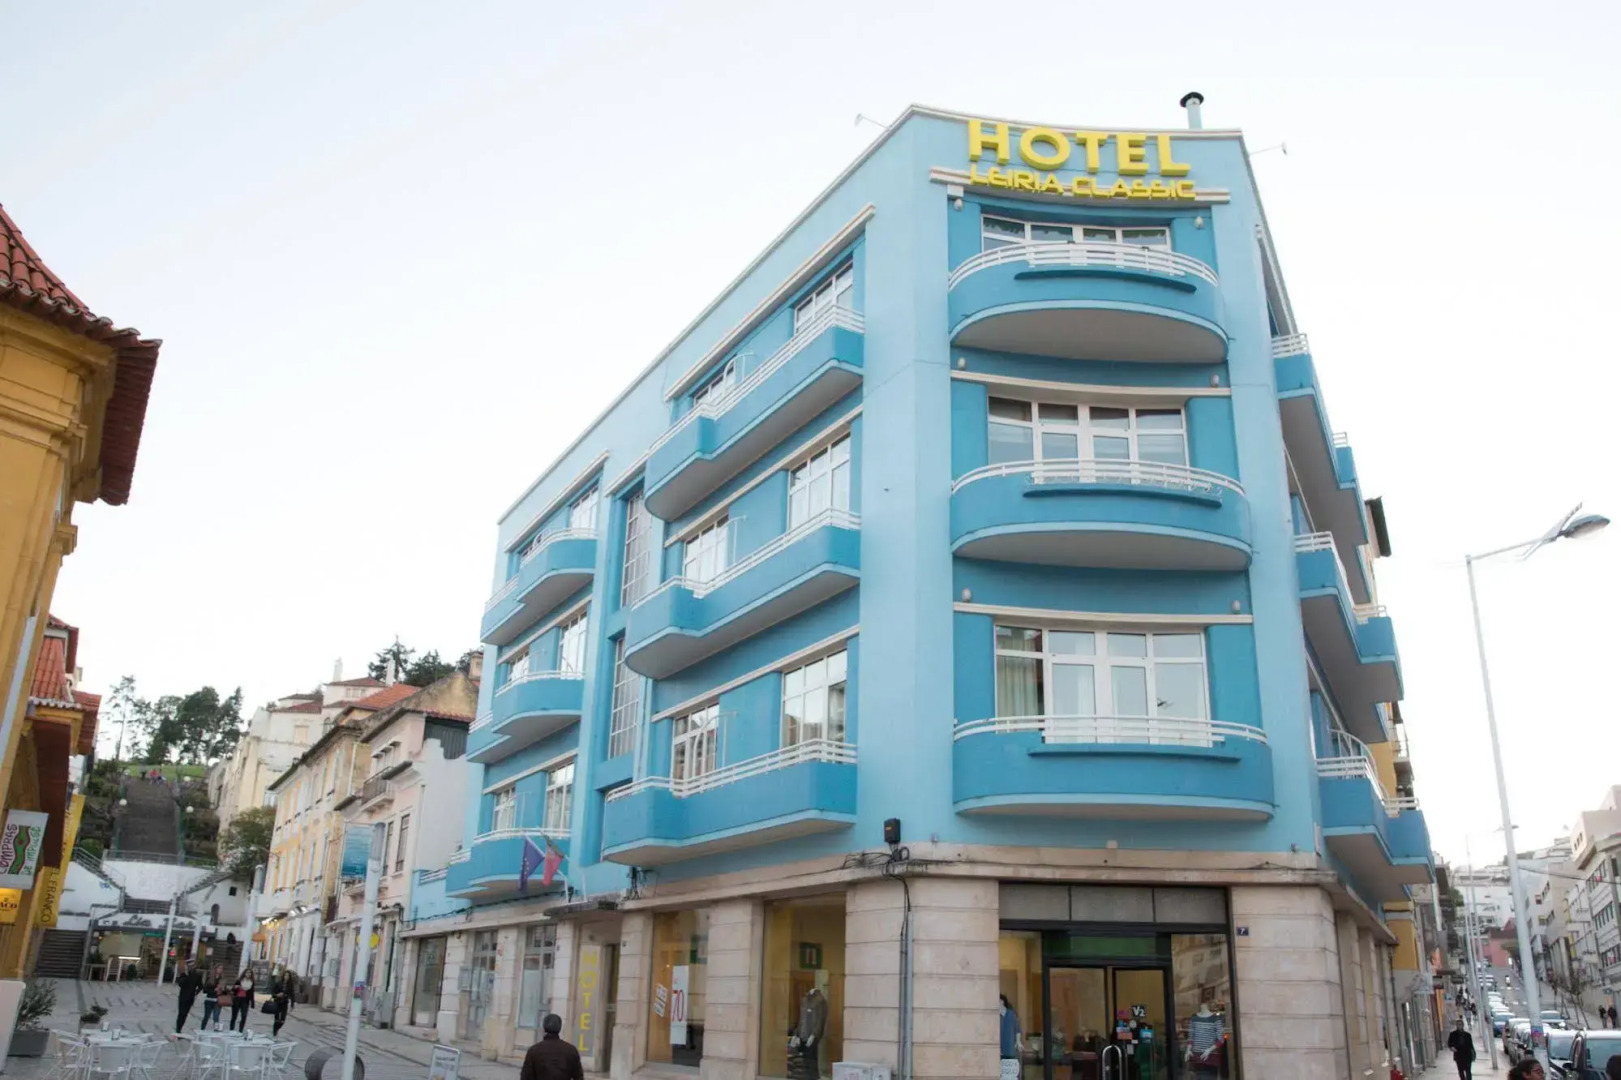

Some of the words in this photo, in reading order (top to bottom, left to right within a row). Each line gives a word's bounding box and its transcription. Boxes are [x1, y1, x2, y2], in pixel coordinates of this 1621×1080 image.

[968, 119, 1190, 176] HOTEL
[970, 162, 1065, 195] LEIRIA
[1072, 176, 1196, 200] CLASSIC
[41, 880, 58, 923] FRANCO
[578, 949, 598, 1052] HOTEL
